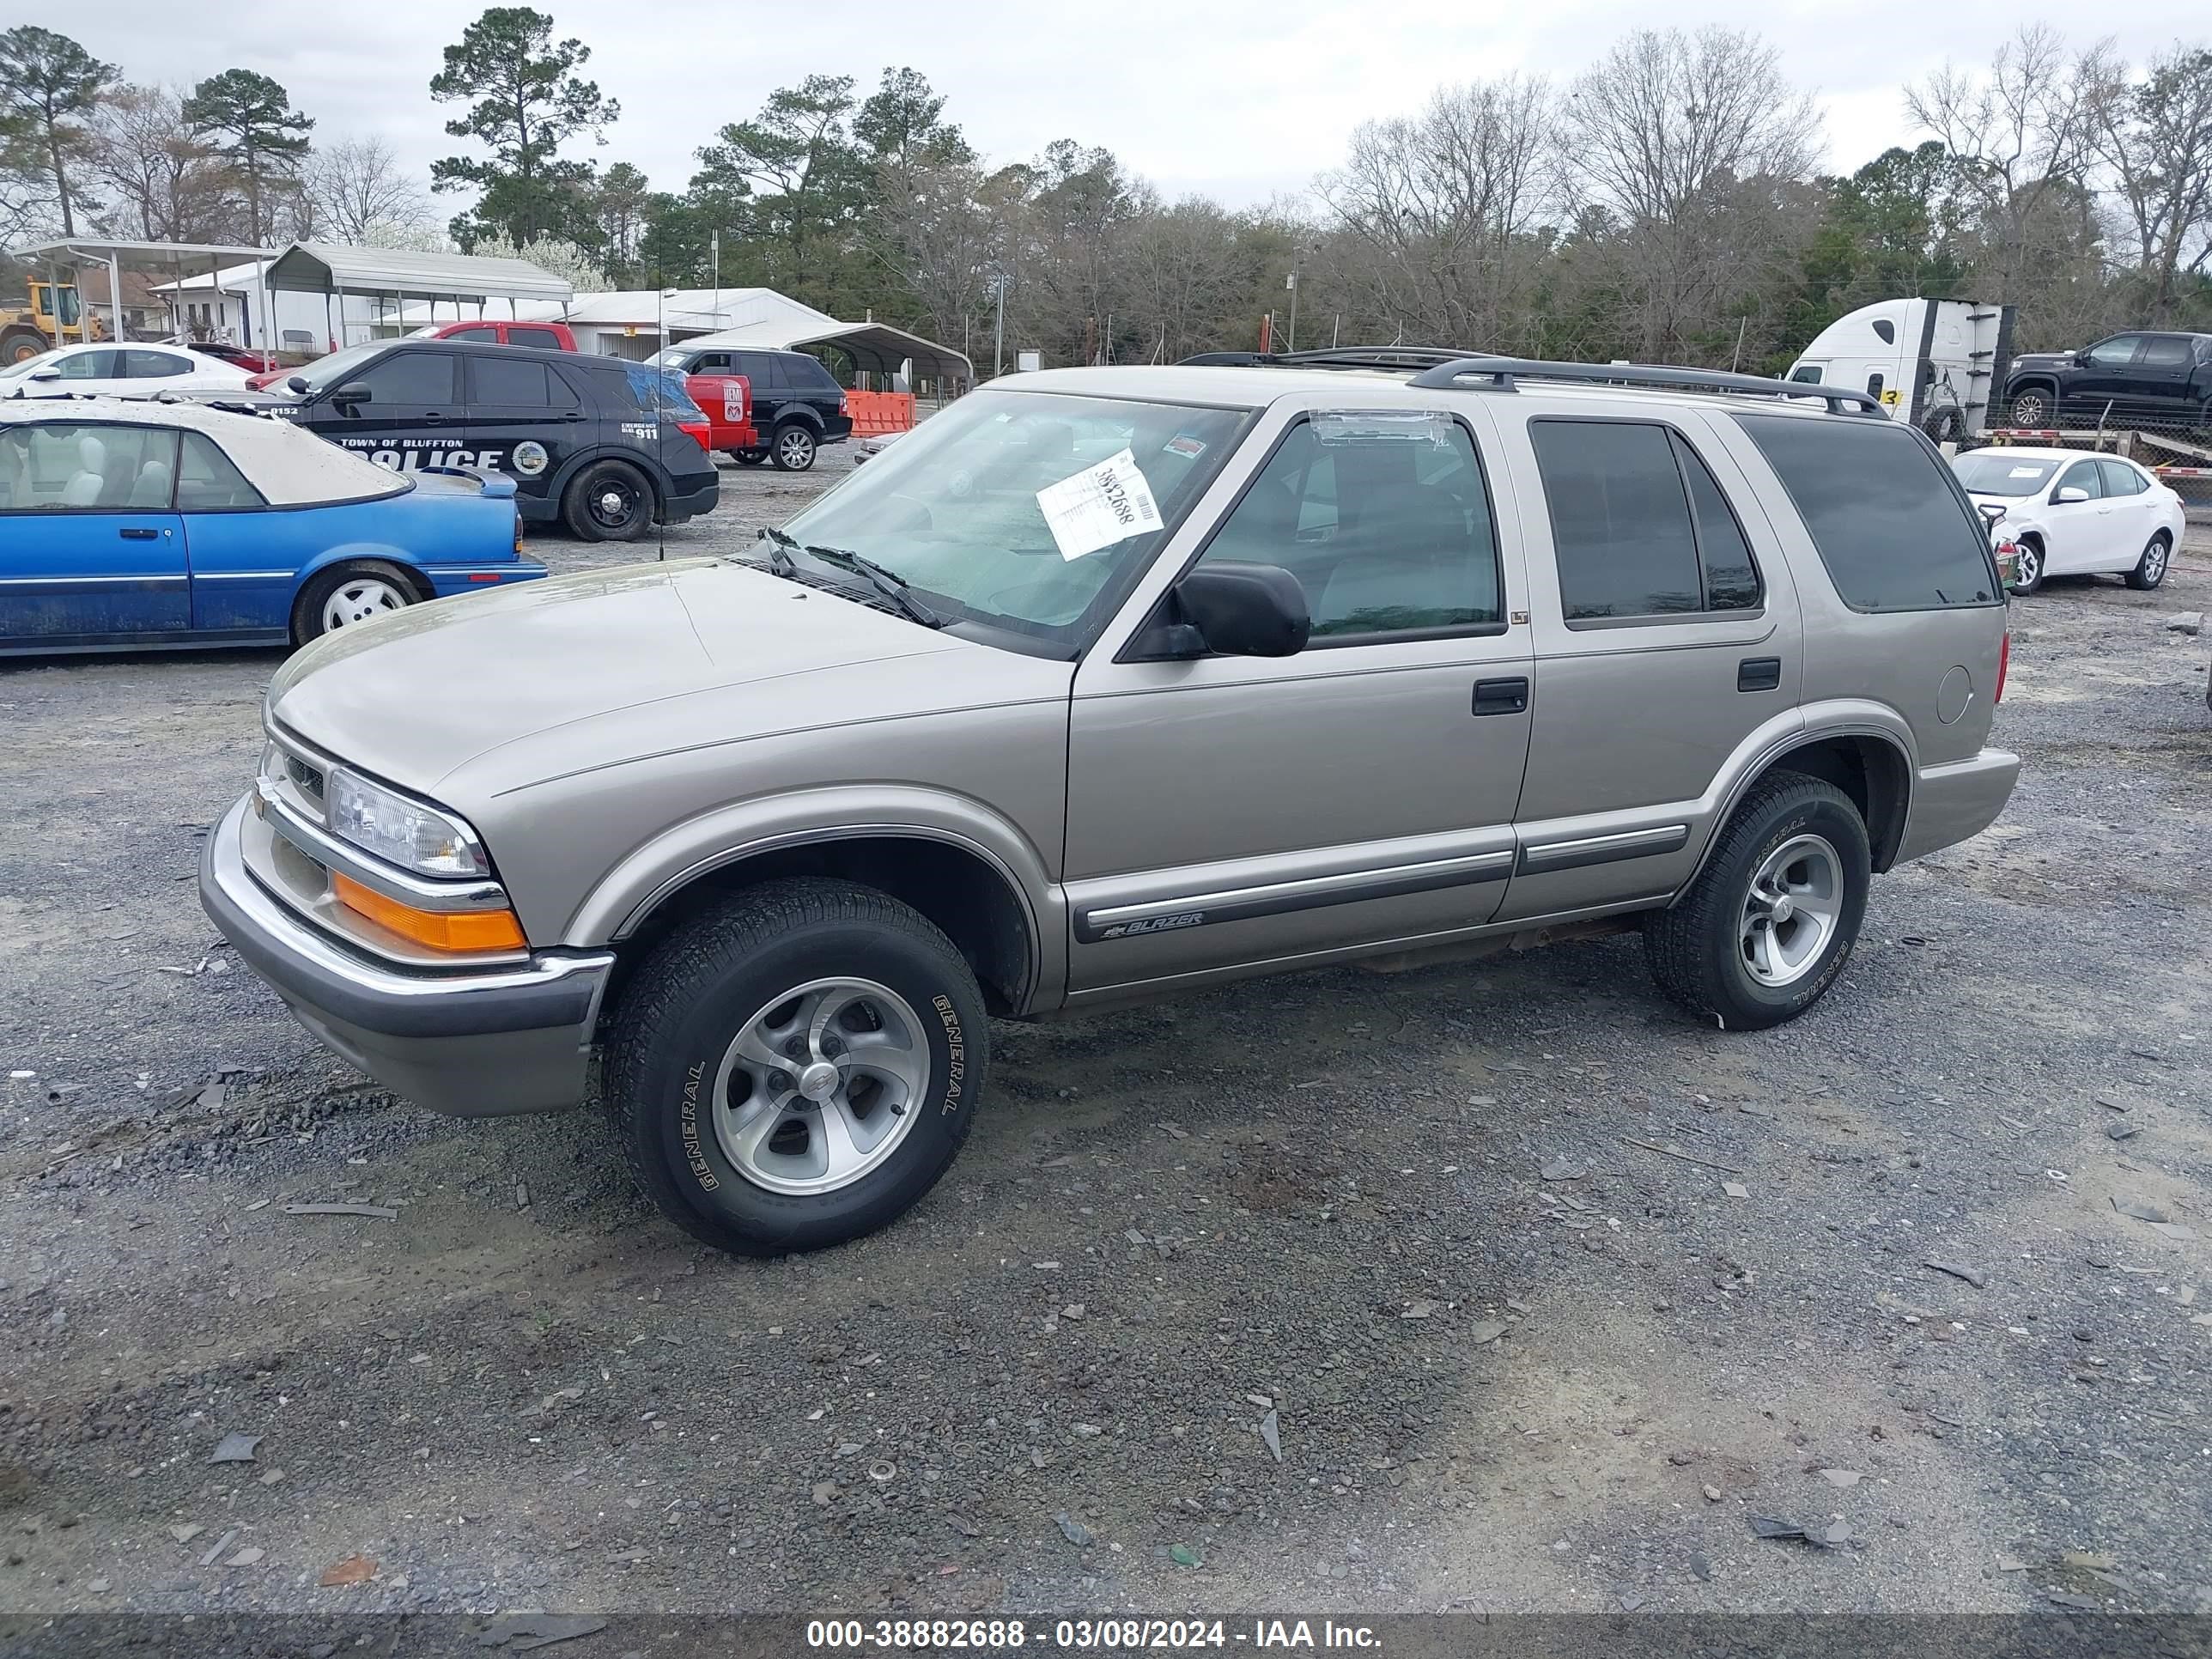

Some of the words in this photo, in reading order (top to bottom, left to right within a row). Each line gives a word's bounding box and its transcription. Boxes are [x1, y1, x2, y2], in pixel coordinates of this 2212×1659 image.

[724, 387, 742, 401] HEMI
[1885, 390, 1898, 404] 3
[635, 428, 658, 440] 911
[340, 439, 376, 447] TOWN
[402, 440, 464, 448] BLUFFTON
[1512, 612, 1528, 623] LT
[1126, 913, 1203, 933] BLAZER
[1792, 940, 1849, 1006] GENERAL
[933, 994, 964, 1115] GENERAL
[682, 1060, 720, 1192] GENERAL
